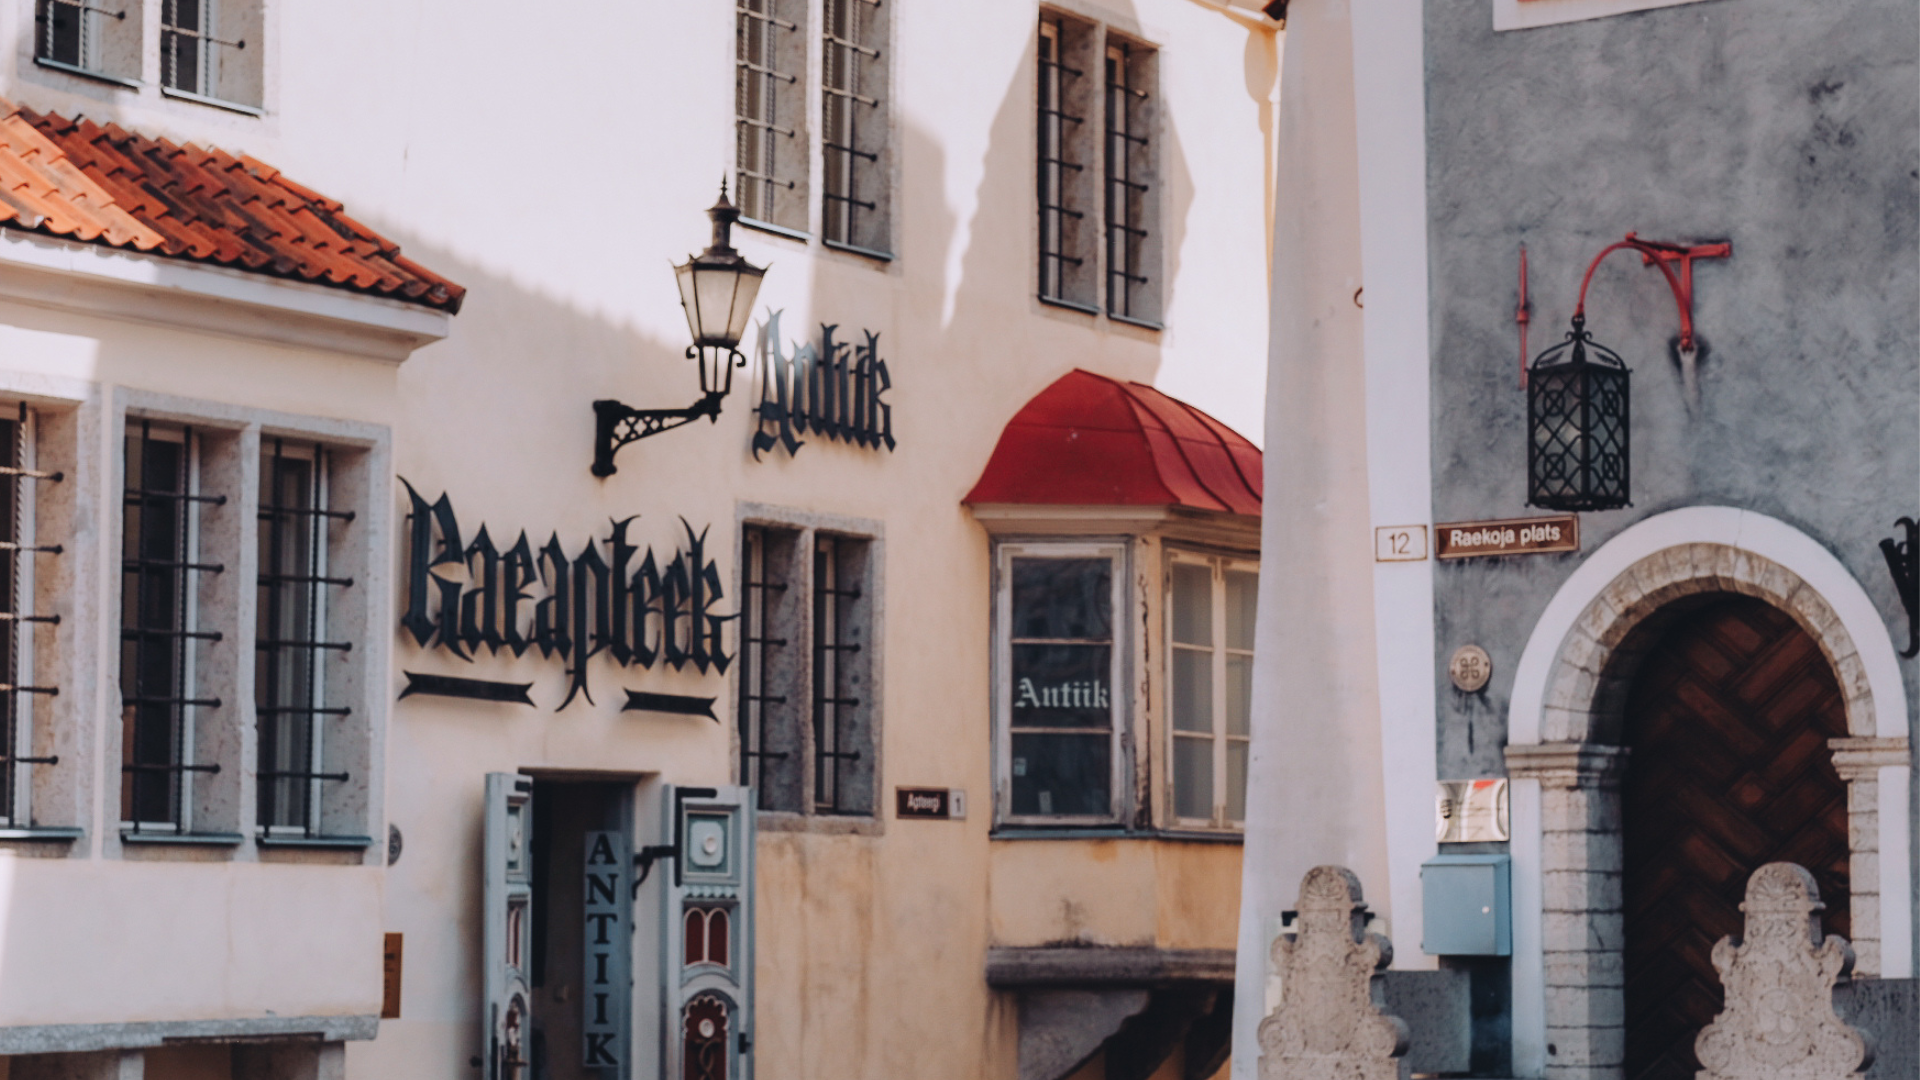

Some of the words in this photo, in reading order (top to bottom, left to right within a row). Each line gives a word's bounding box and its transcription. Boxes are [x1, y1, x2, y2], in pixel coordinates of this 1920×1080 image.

[753, 306, 896, 463] Antiik
[1389, 532, 1410, 555] 12
[1450, 526, 1515, 548] Raekoja
[1520, 523, 1560, 546] plats
[1014, 677, 1109, 709] Antiik
[586, 833, 618, 1065] ANTIIK
